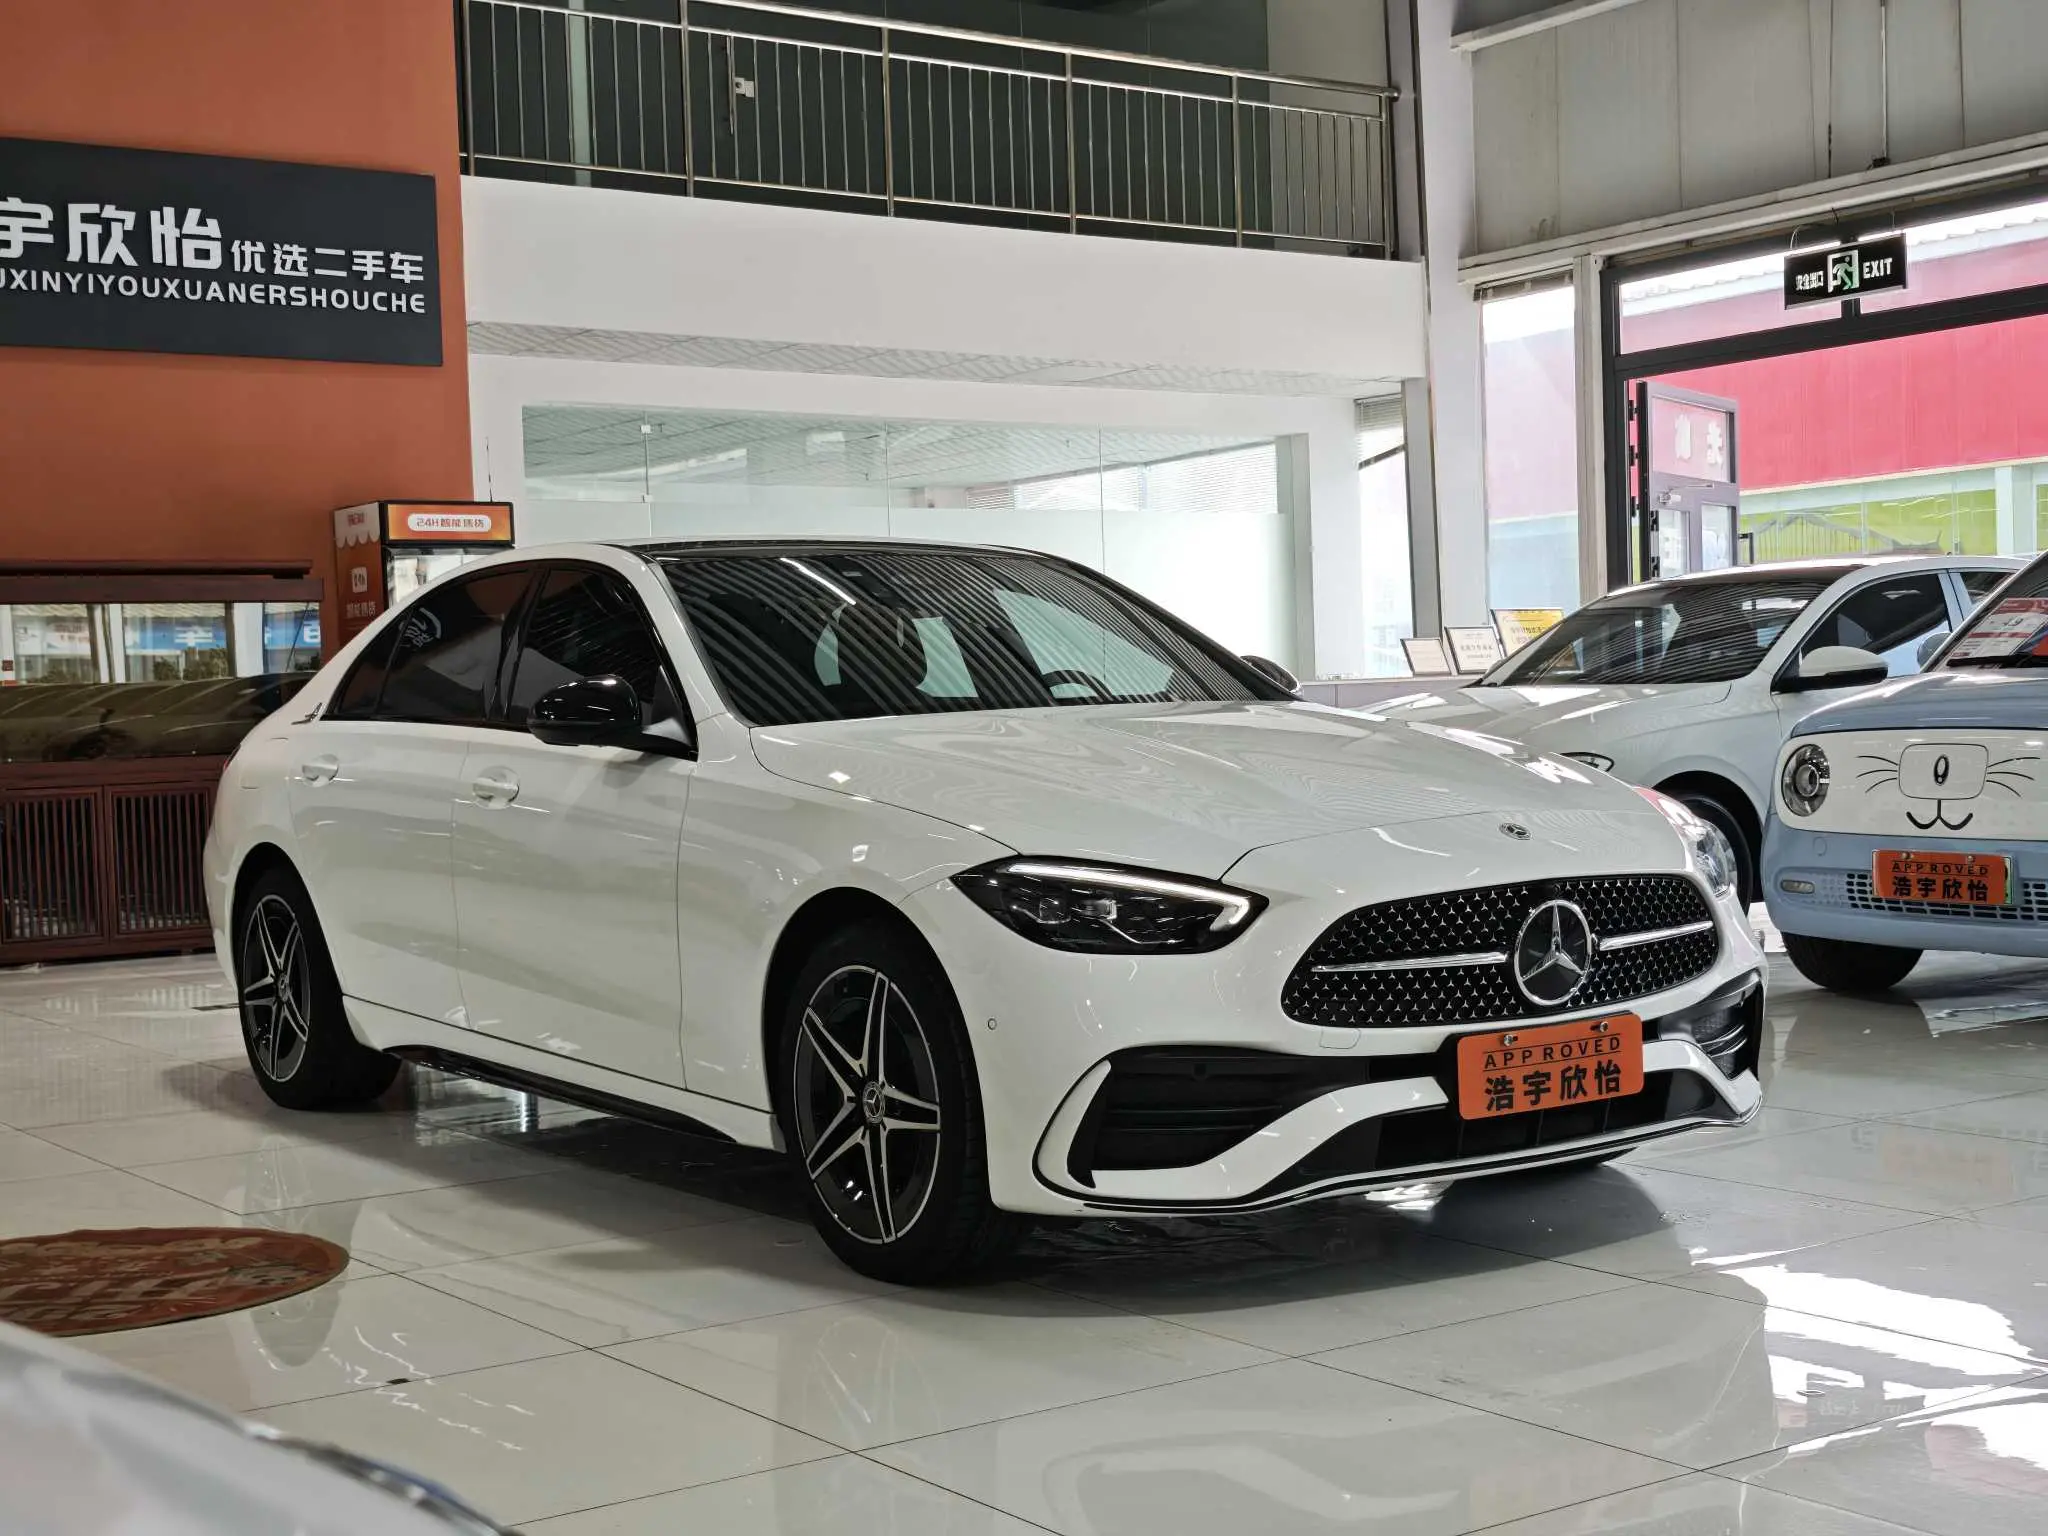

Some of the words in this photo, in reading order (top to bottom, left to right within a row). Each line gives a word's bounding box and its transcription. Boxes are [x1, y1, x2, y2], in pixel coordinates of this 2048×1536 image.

[0, 197, 223, 270] 宇欣怡
[231, 239, 425, 284] 优选二手车
[1862, 257, 1893, 279] EXIT
[1891, 861, 1989, 876] APPROVED
[1892, 876, 1989, 901] 浩宇欣怡
[1484, 1036, 1621, 1069] APPROVED
[1484, 1059, 1622, 1112] 浩宇欣怡
